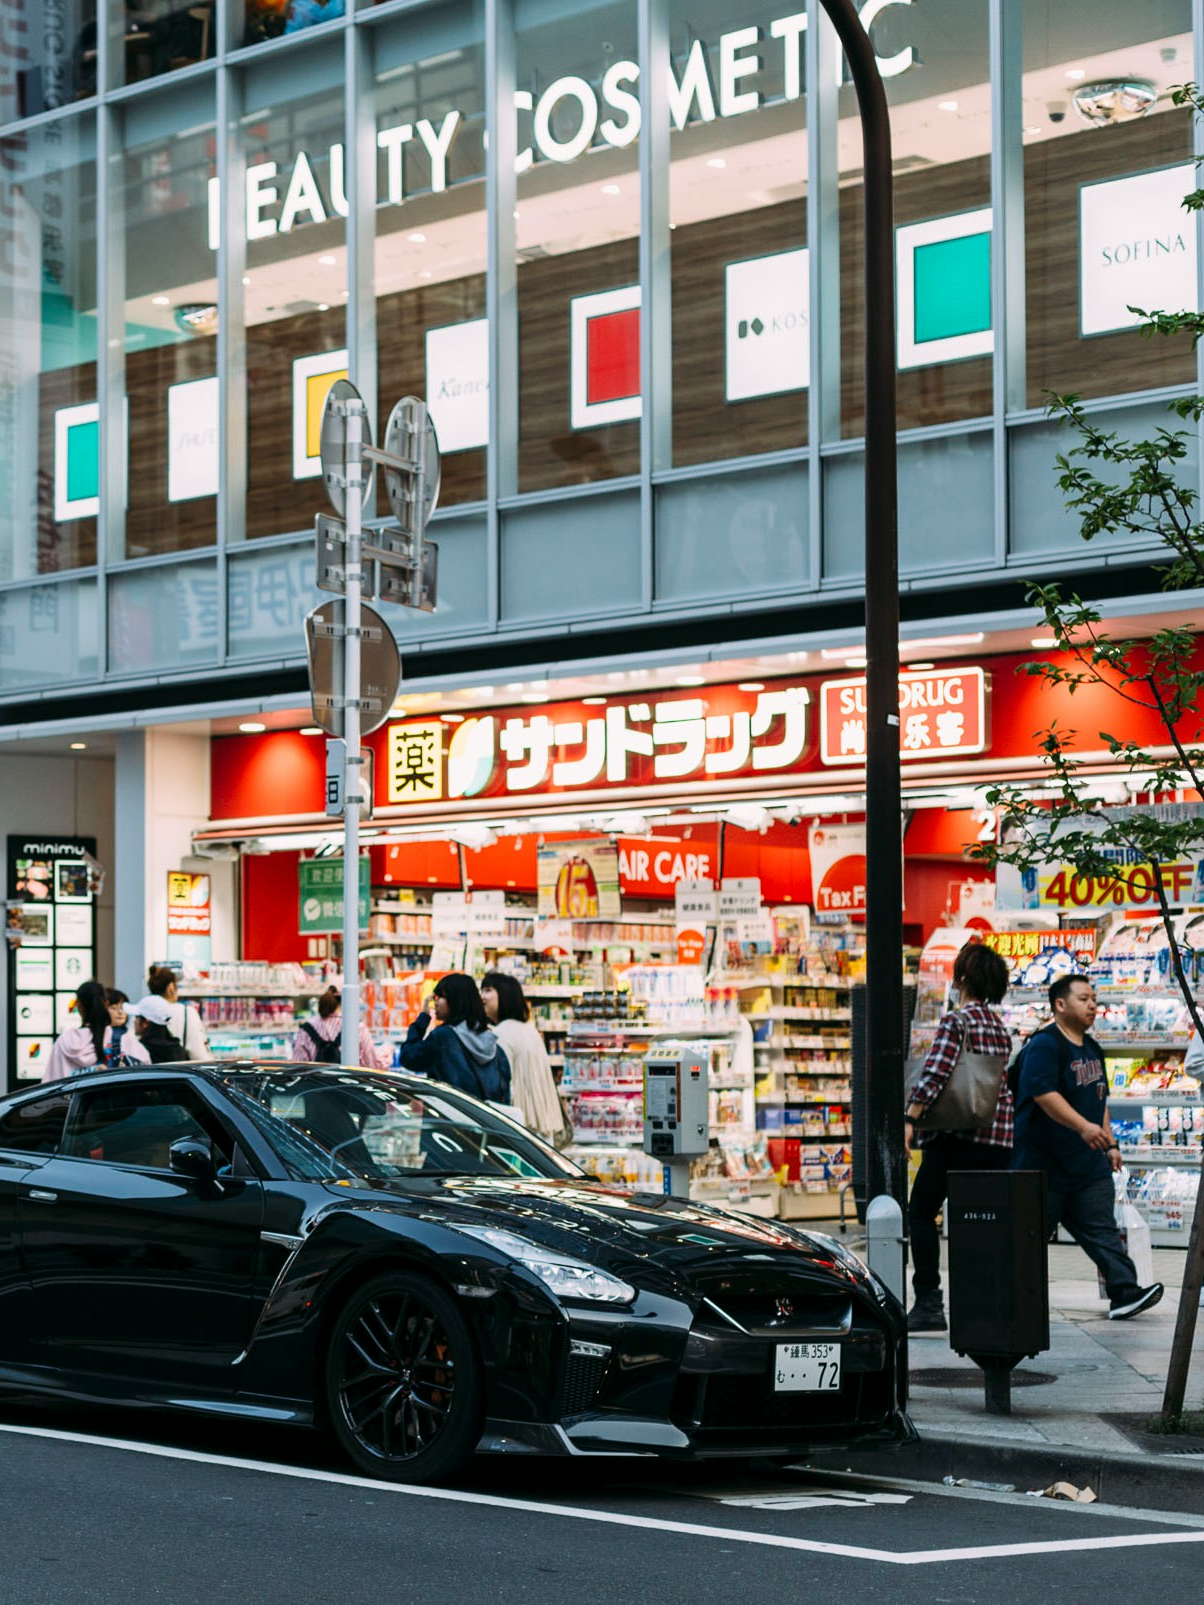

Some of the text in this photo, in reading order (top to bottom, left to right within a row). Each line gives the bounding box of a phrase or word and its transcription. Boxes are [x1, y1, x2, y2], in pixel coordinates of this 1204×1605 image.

[1101, 234, 1186, 268] SOFINA
[772, 312, 809, 332] KOS
[840, 678, 964, 715] SUDRUG
[500, 687, 810, 792] サンドラッグ
[840, 710, 964, 755] 尚乐客
[395, 730, 435, 792] 薬
[23, 843, 86, 855] minimu
[618, 849, 649, 881] AIR
[654, 851, 710, 883] CARE
[820, 887, 852, 908] Tax
[811, 1344, 829, 1359] 353
[817, 1361, 840, 1389] 72
